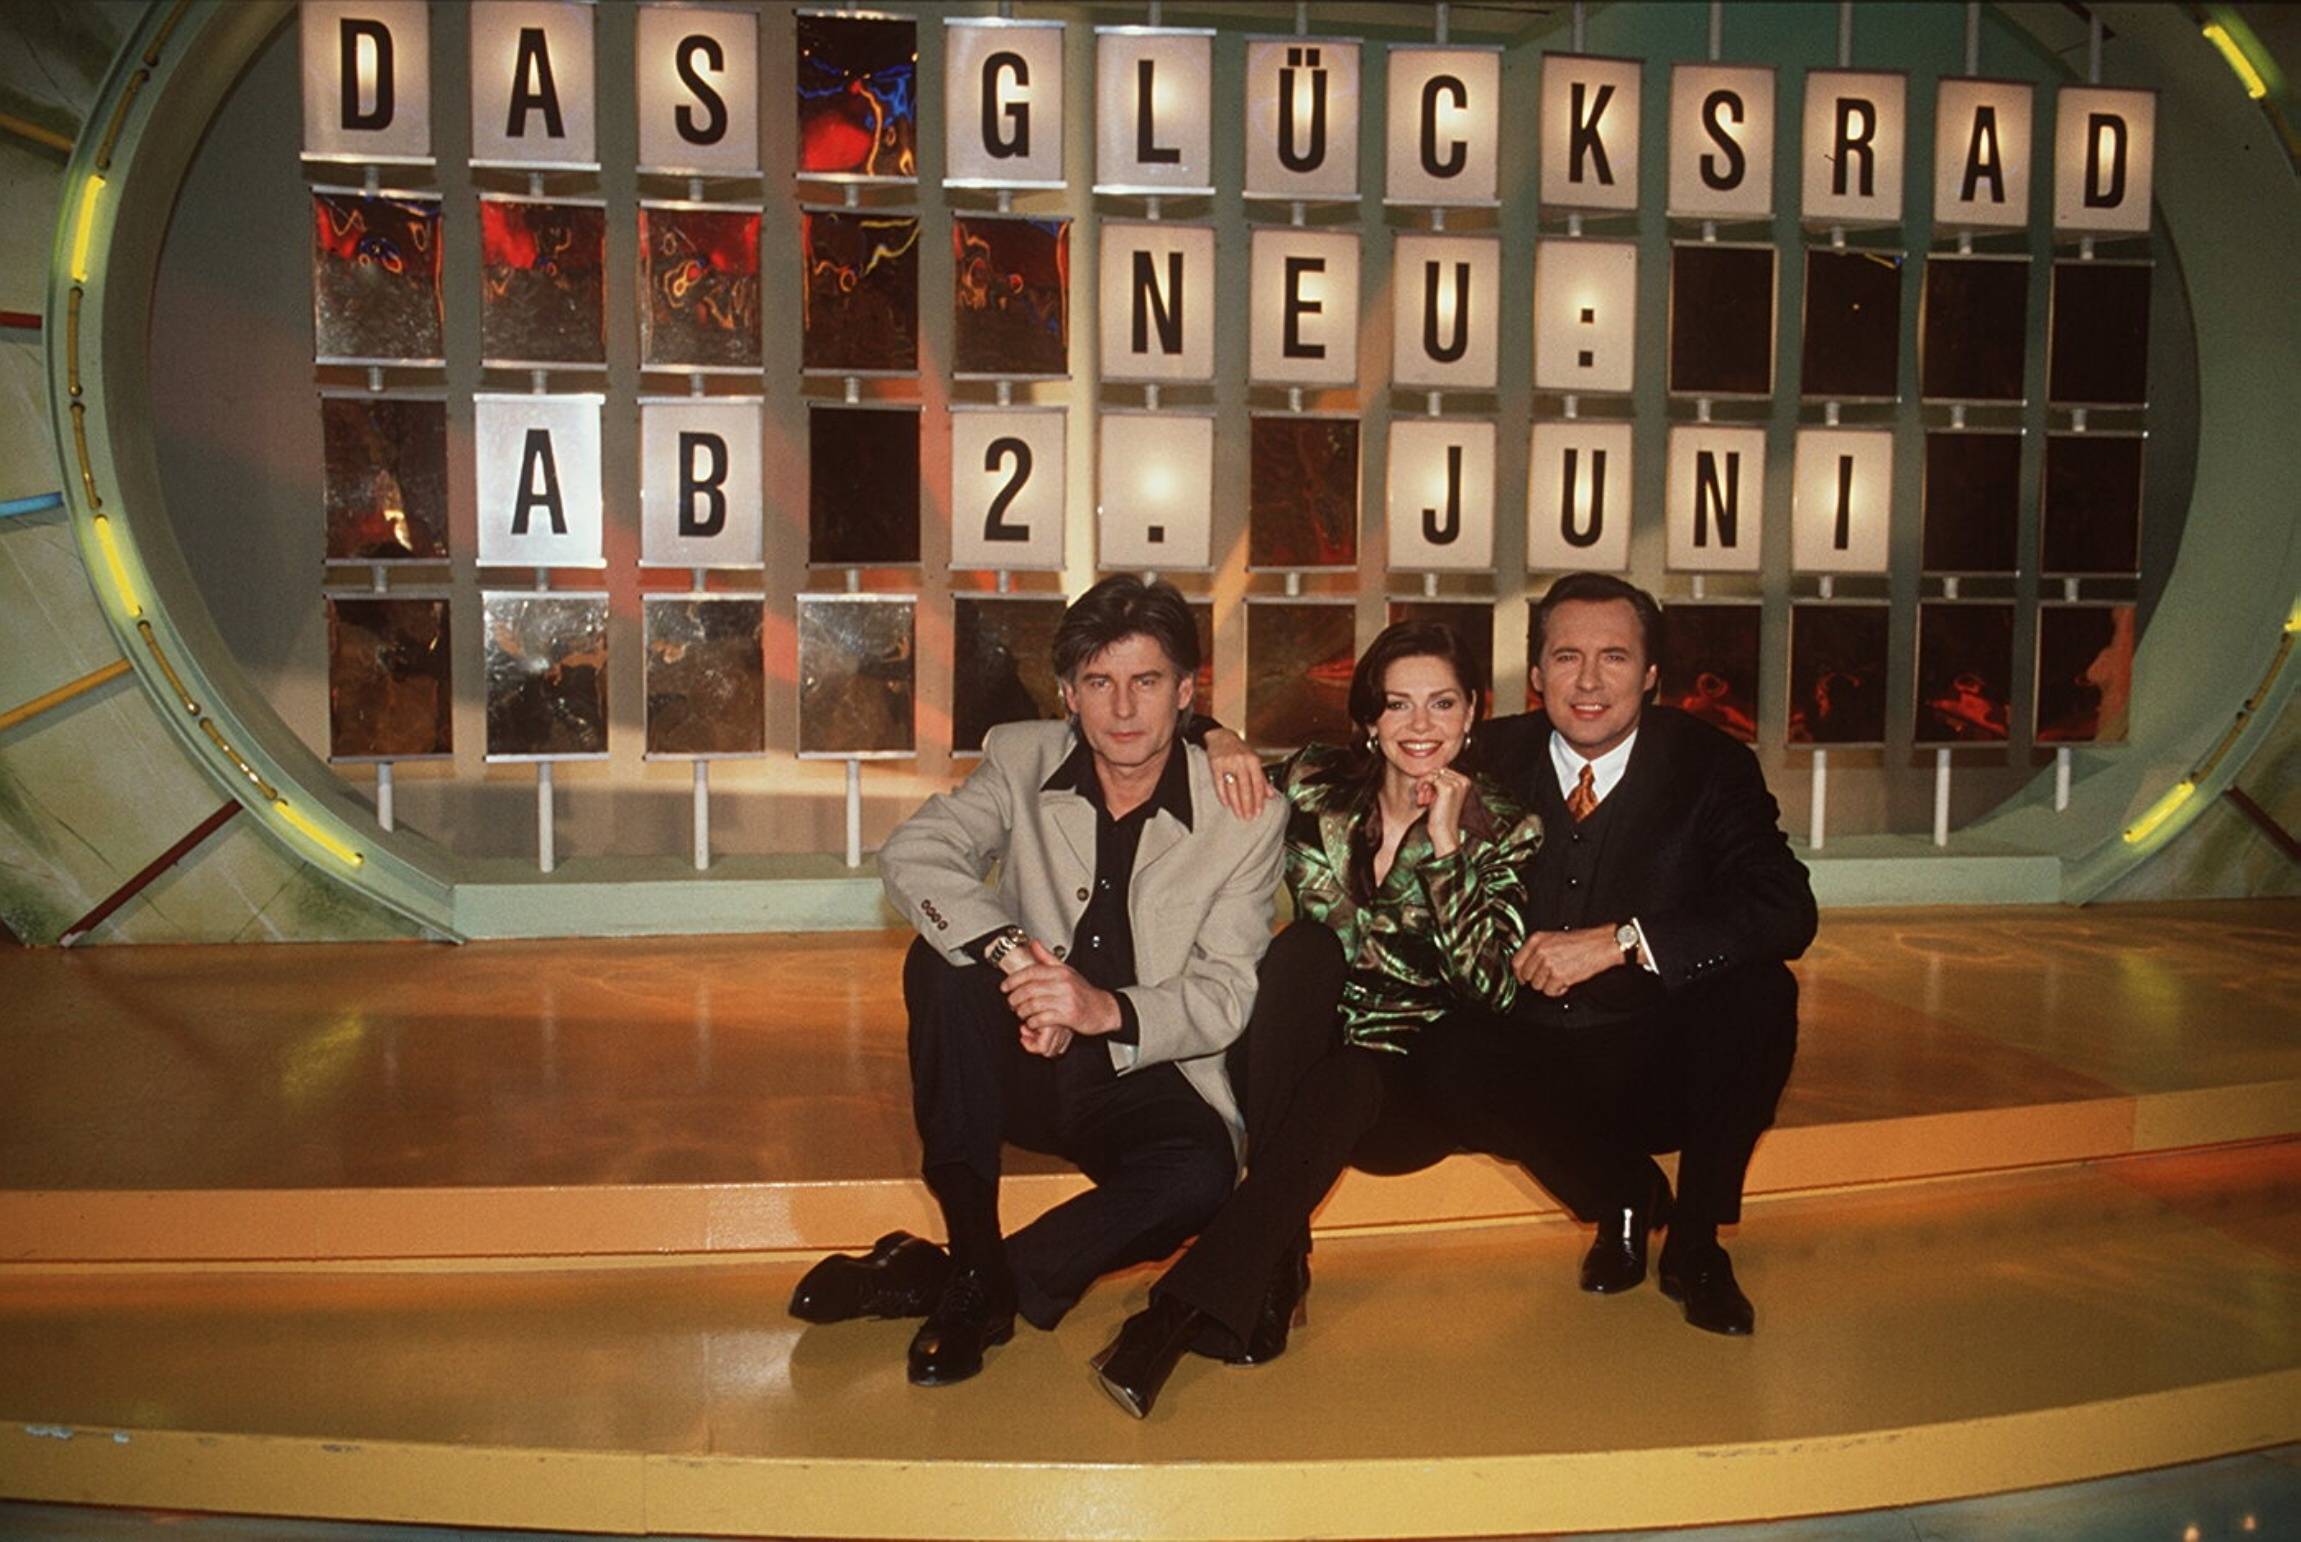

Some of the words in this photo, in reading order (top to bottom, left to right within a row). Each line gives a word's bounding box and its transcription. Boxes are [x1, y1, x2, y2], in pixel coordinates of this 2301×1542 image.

[340, 17, 728, 145] DAS
[981, 48, 2128, 209] GLÜCKSRAD
[1131, 250, 1594, 367] NEU:
[511, 428, 728, 538] AB
[983, 437, 1164, 543] 2.
[1421, 446, 1853, 550] JUNI
